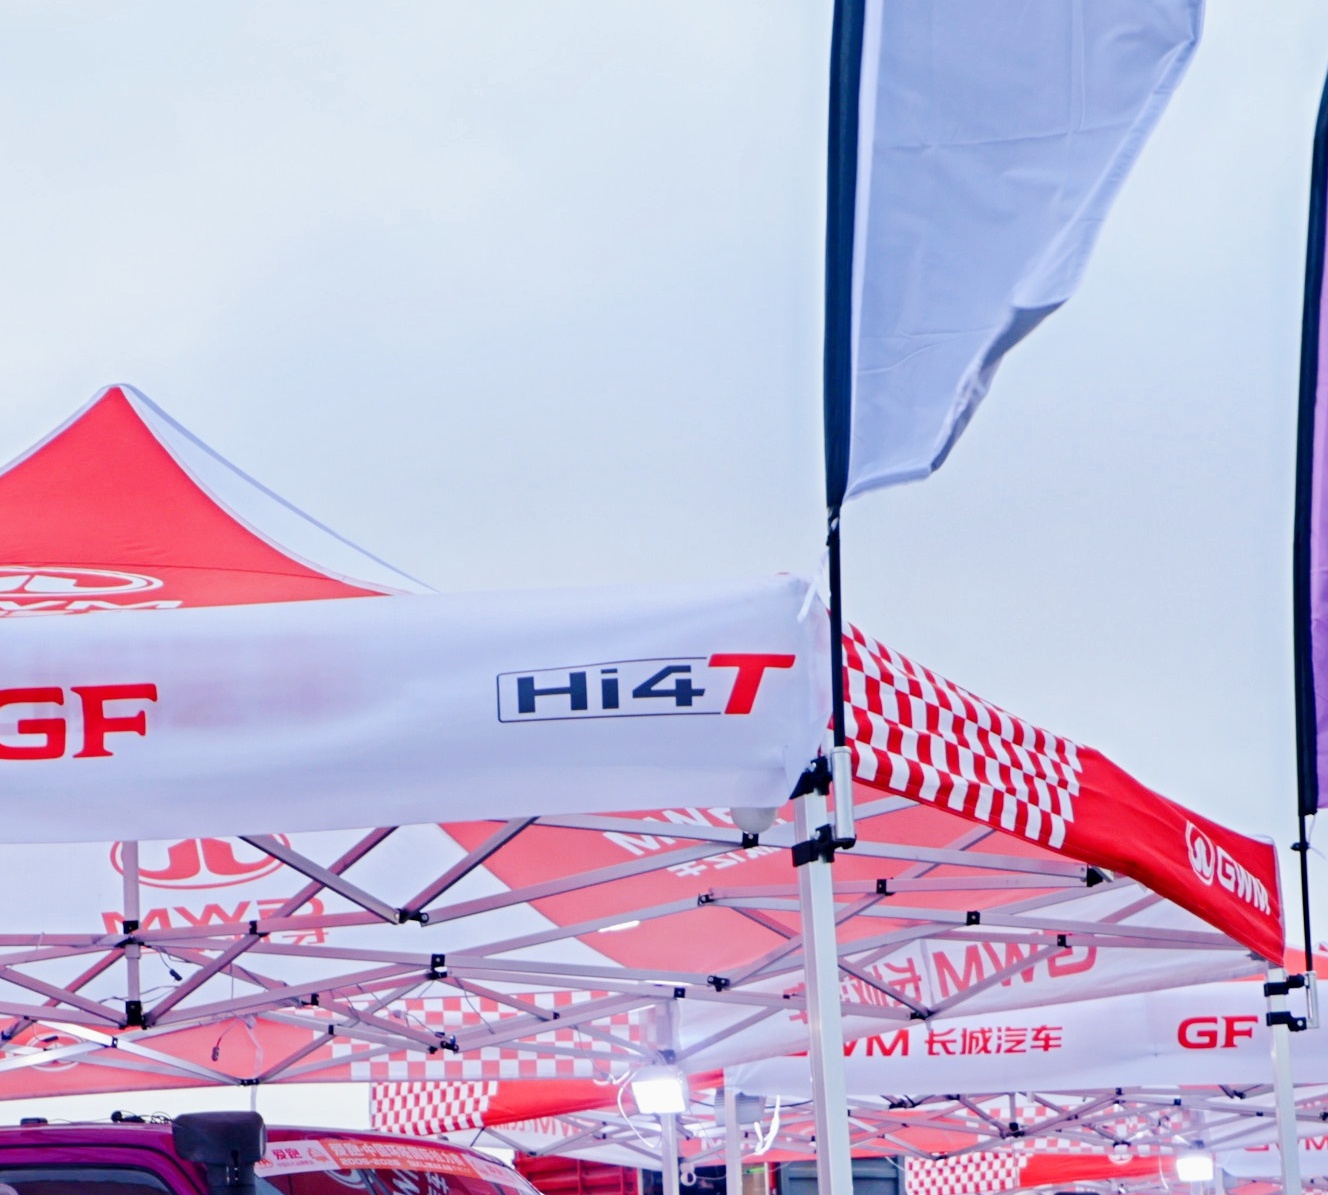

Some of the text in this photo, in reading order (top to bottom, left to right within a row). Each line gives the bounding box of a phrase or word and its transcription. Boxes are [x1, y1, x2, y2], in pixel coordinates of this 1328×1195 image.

[516, 653, 796, 714] Hi4T
[1217, 845, 1271, 915] GWM
[925, 1025, 1063, 1055] 长城汽车
[1178, 1015, 1258, 1049] GF
